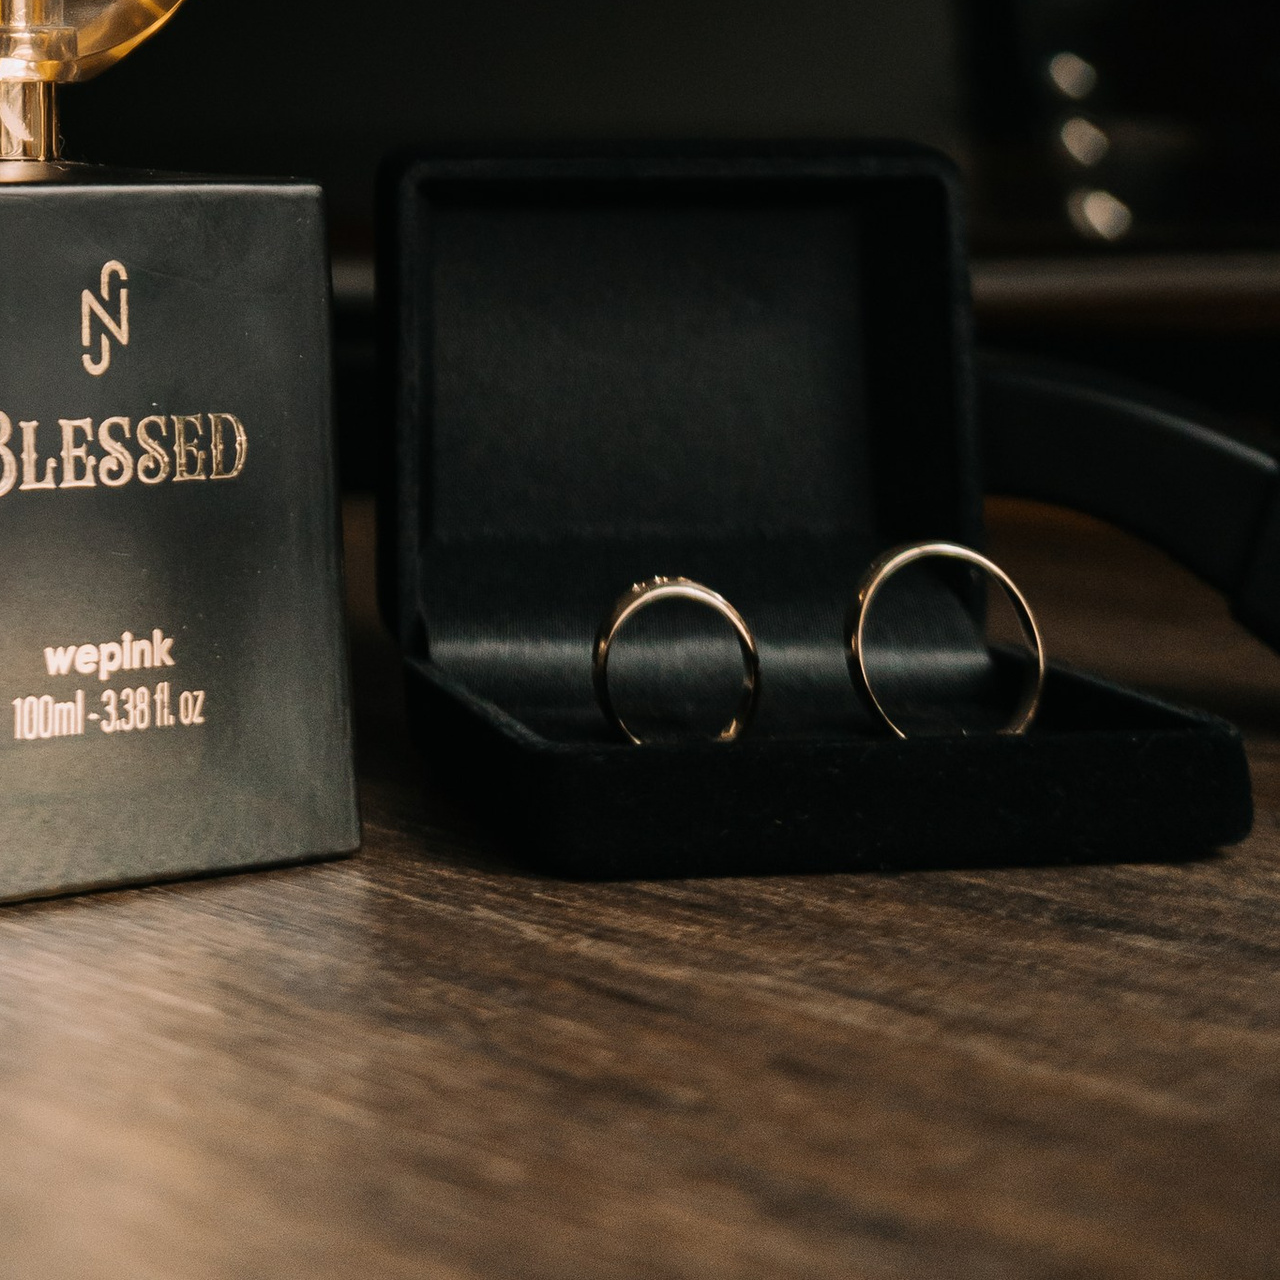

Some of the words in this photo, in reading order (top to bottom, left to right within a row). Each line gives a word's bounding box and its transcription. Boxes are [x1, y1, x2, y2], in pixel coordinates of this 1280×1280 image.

[43, 628, 175, 681] wepink
[12, 689, 85, 739] 100ml
[179, 690, 205, 725] oz
